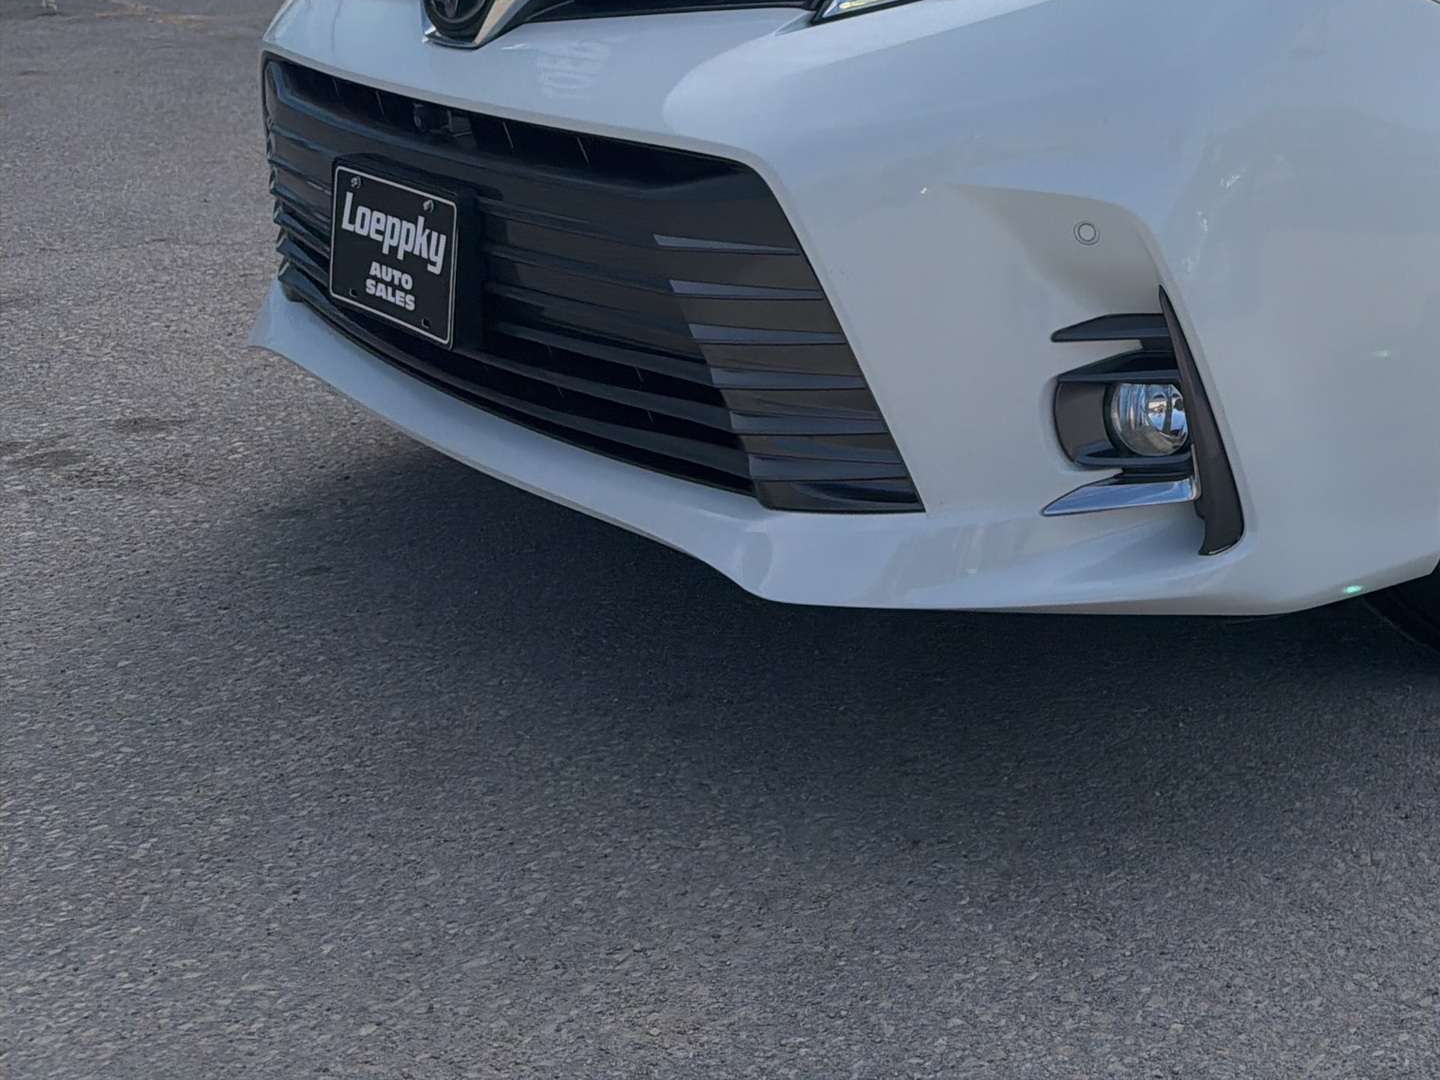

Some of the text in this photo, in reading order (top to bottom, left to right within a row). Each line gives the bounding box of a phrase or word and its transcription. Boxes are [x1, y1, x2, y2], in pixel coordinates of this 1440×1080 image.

[341, 192, 447, 275] Loeppky
[369, 261, 413, 290] AUTO
[365, 279, 416, 311] SALES
